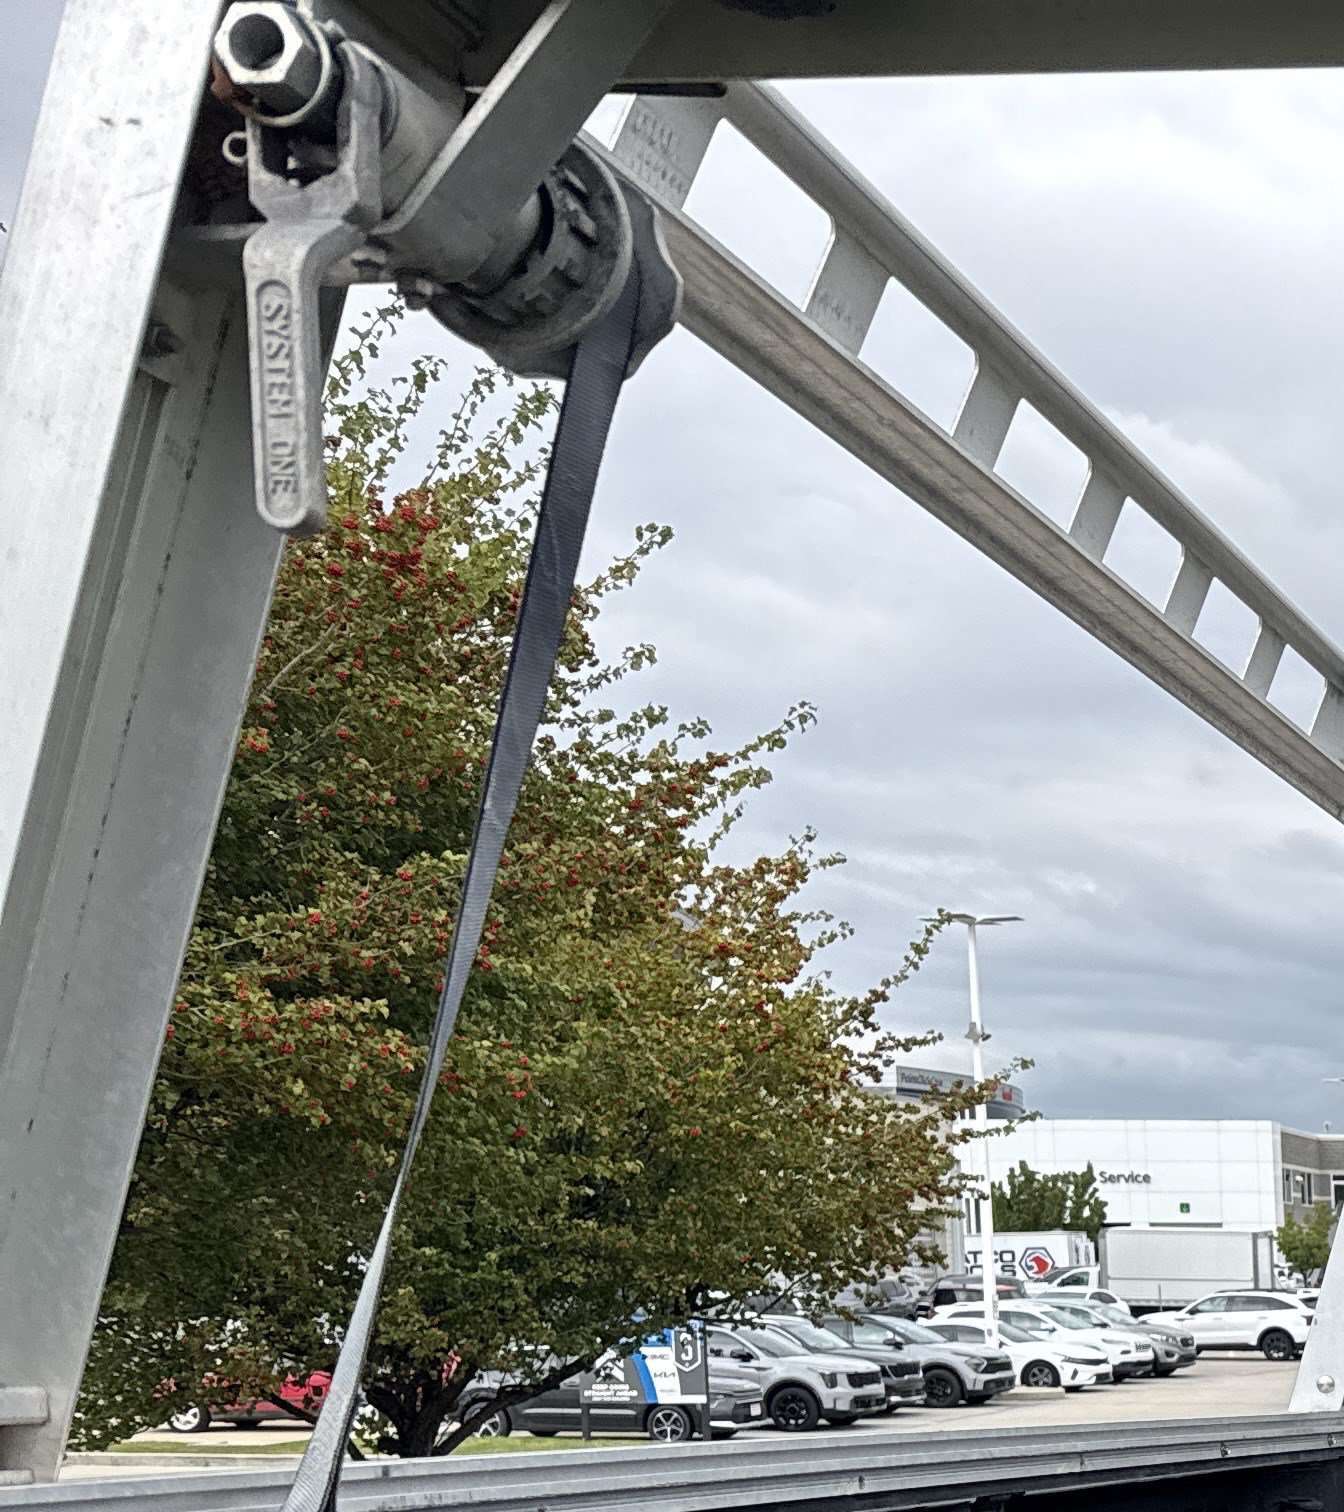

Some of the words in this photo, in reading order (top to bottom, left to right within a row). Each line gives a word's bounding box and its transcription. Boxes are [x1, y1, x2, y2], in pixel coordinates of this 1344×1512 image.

[262, 302, 295, 418] SYSTEM
[267, 440, 297, 494] ONE
[1098, 1170, 1152, 1184] Service
